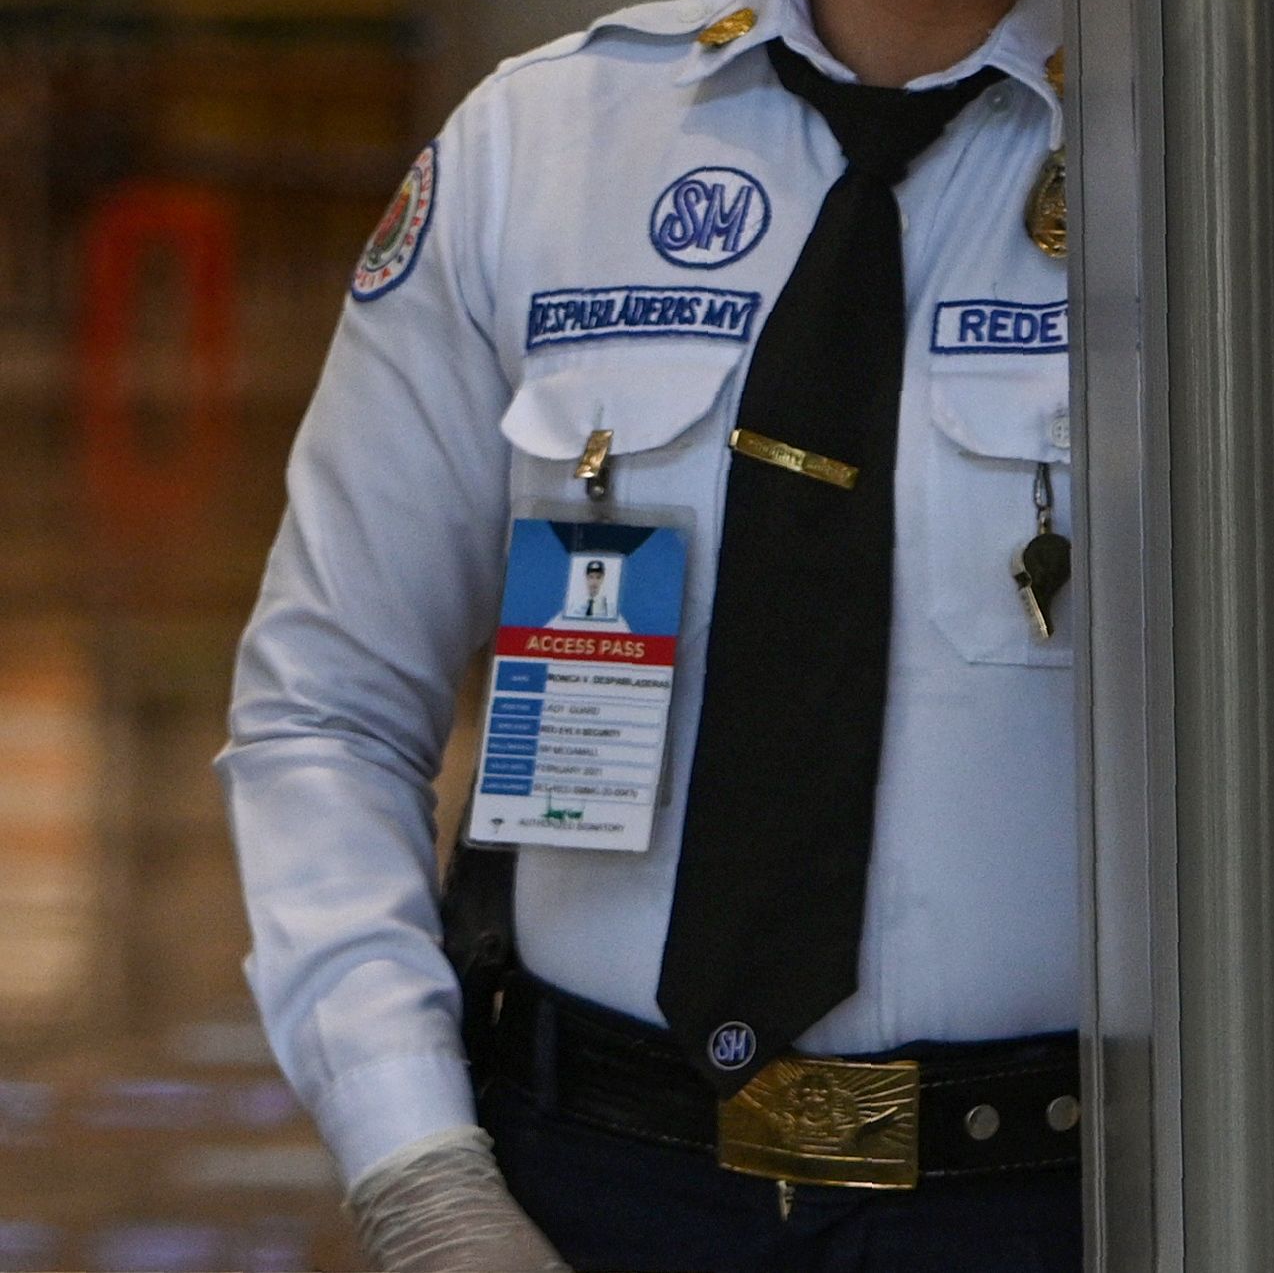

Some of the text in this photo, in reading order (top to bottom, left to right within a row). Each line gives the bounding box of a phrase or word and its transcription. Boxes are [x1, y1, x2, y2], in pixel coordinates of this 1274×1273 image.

[658, 179, 754, 254] SM
[527, 635, 645, 658] ACCESS PASS
[714, 1028, 747, 1062] SM
